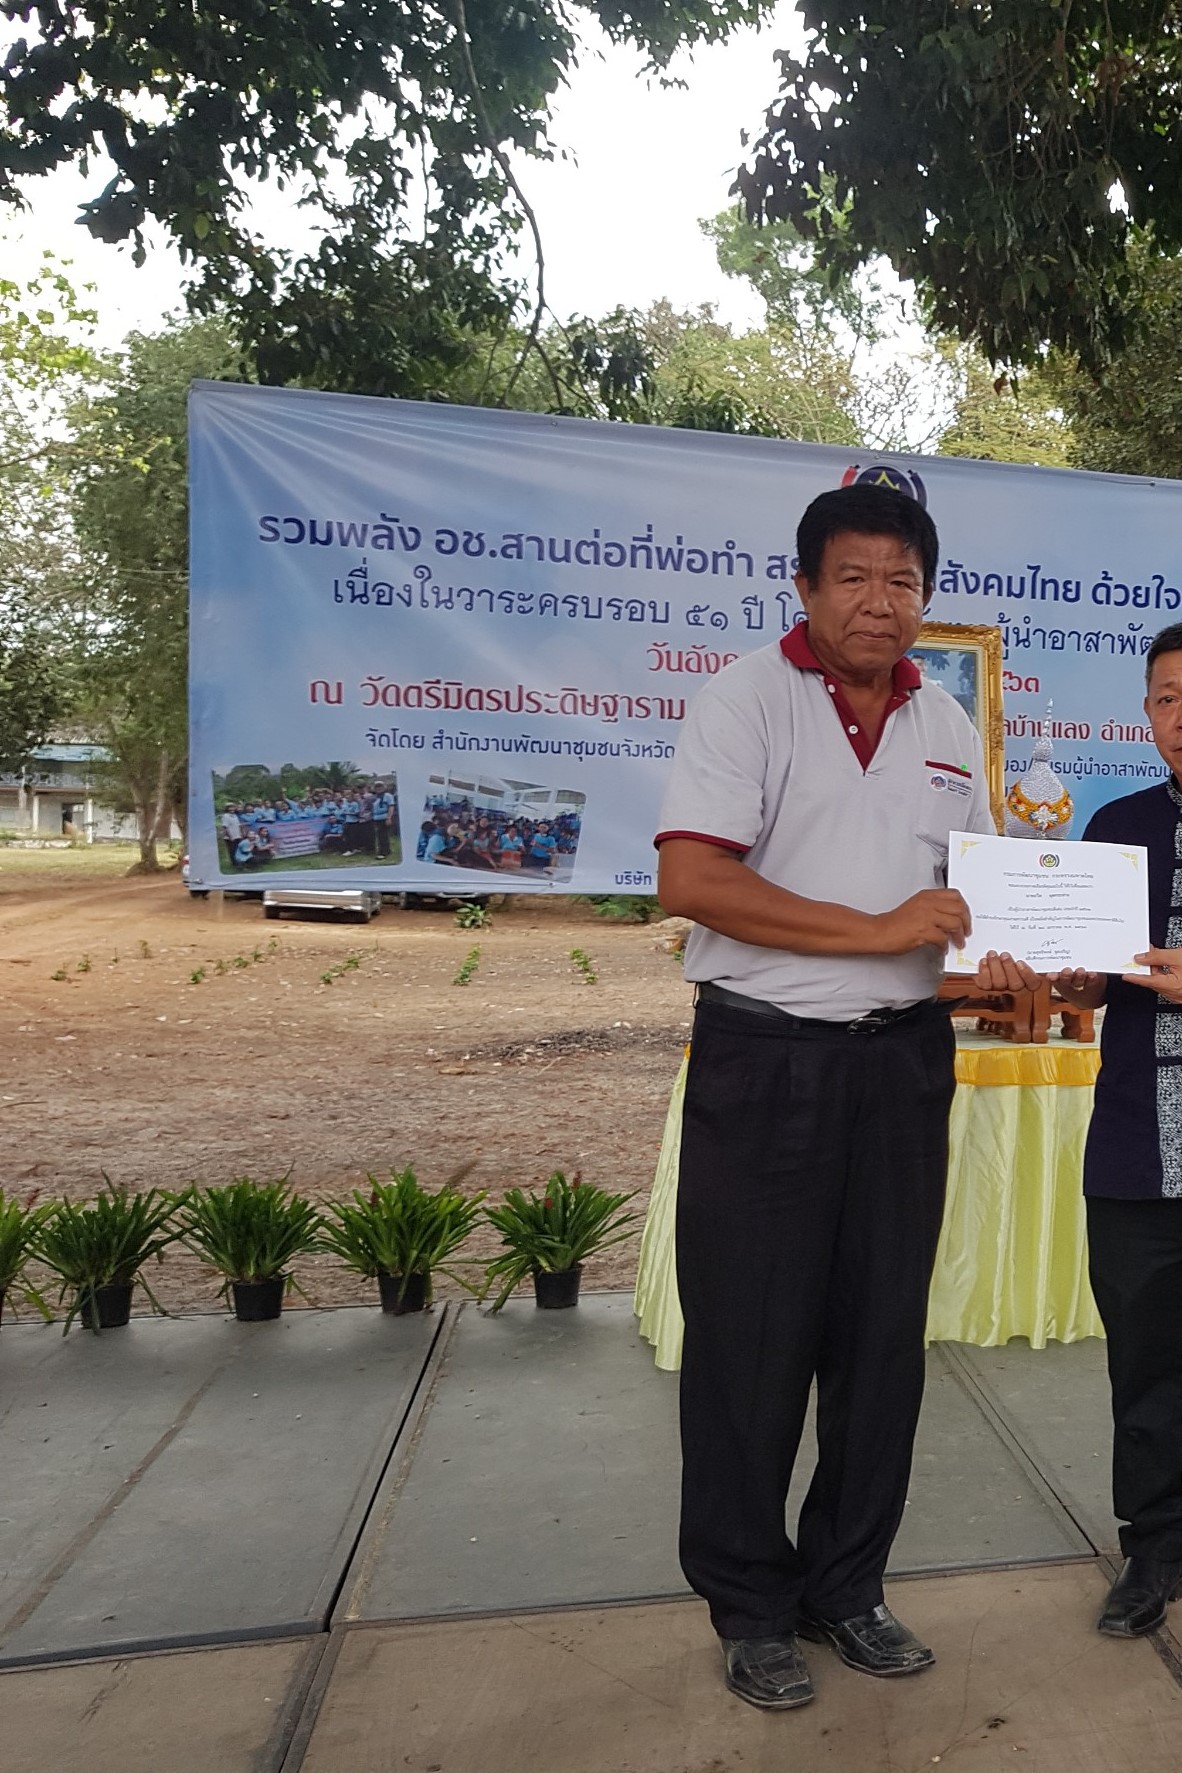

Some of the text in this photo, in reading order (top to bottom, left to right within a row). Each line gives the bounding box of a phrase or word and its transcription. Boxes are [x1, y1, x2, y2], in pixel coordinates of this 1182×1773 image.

[258, 513, 422, 551] รวมพลัง
[434, 524, 754, 577] อช.สานต่อที่พ่อทำ
[932, 559, 1082, 603] สังคมไทย
[333, 557, 671, 624] เนื่องในวาระครบรอบ
[685, 603, 729, 631] ๕๑
[741, 594, 764, 630] ปี
[309, 679, 344, 705] ณ
[360, 674, 687, 723] วัดตรีมิตรประดิษฐาราม
[365, 727, 426, 749] จัดโดย
[614, 870, 652, 885] บริษัท
